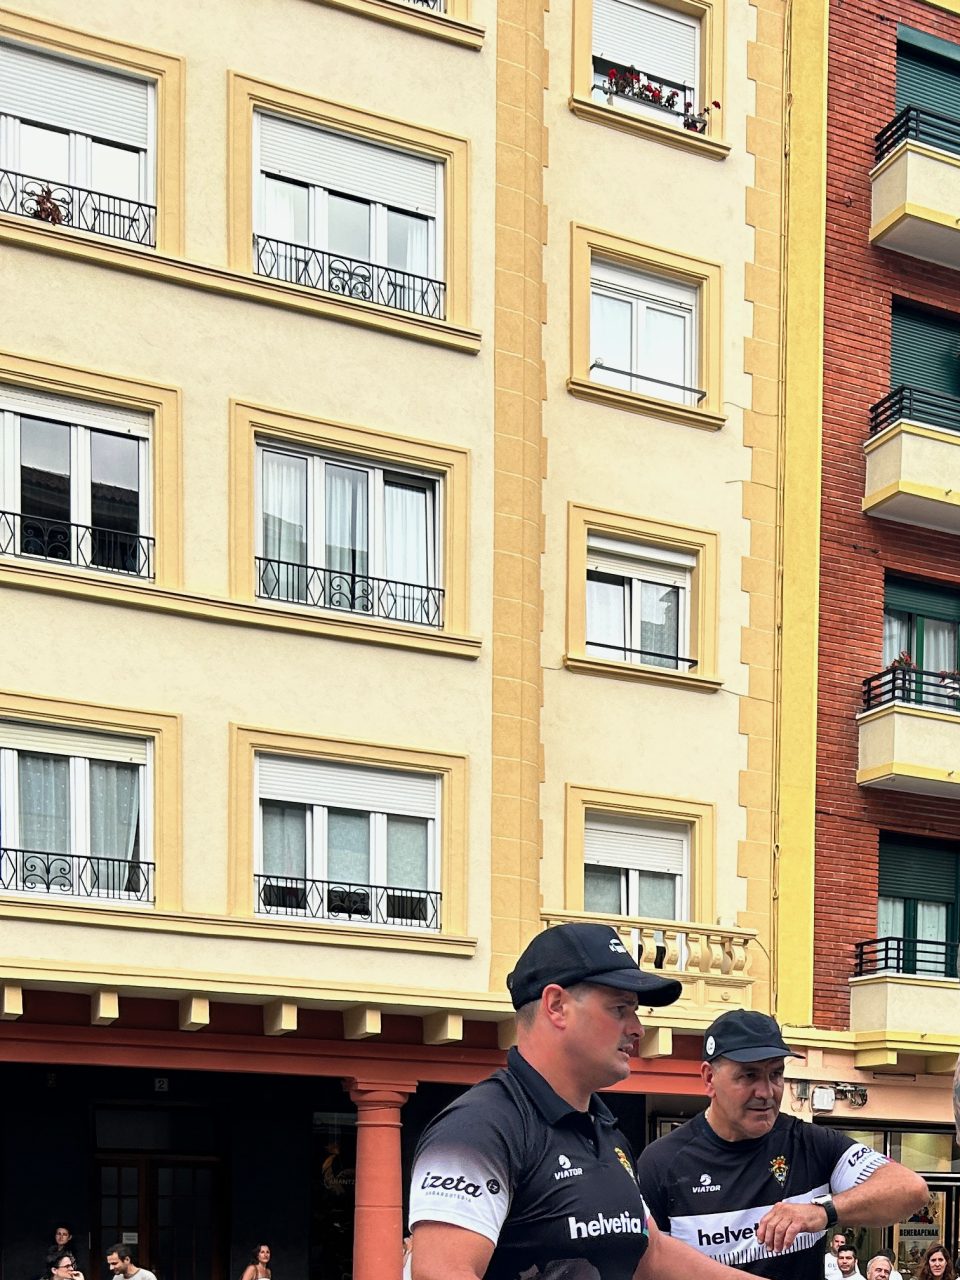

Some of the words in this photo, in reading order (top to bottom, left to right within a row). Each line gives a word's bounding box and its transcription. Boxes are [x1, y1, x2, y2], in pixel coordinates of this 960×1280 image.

[421, 1171, 483, 1198] izeta
[554, 1167, 583, 1180] VIATOR
[692, 1184, 721, 1194] VIATOR
[568, 1210, 641, 1240] helvetia
[697, 1222, 760, 1247] helvet
